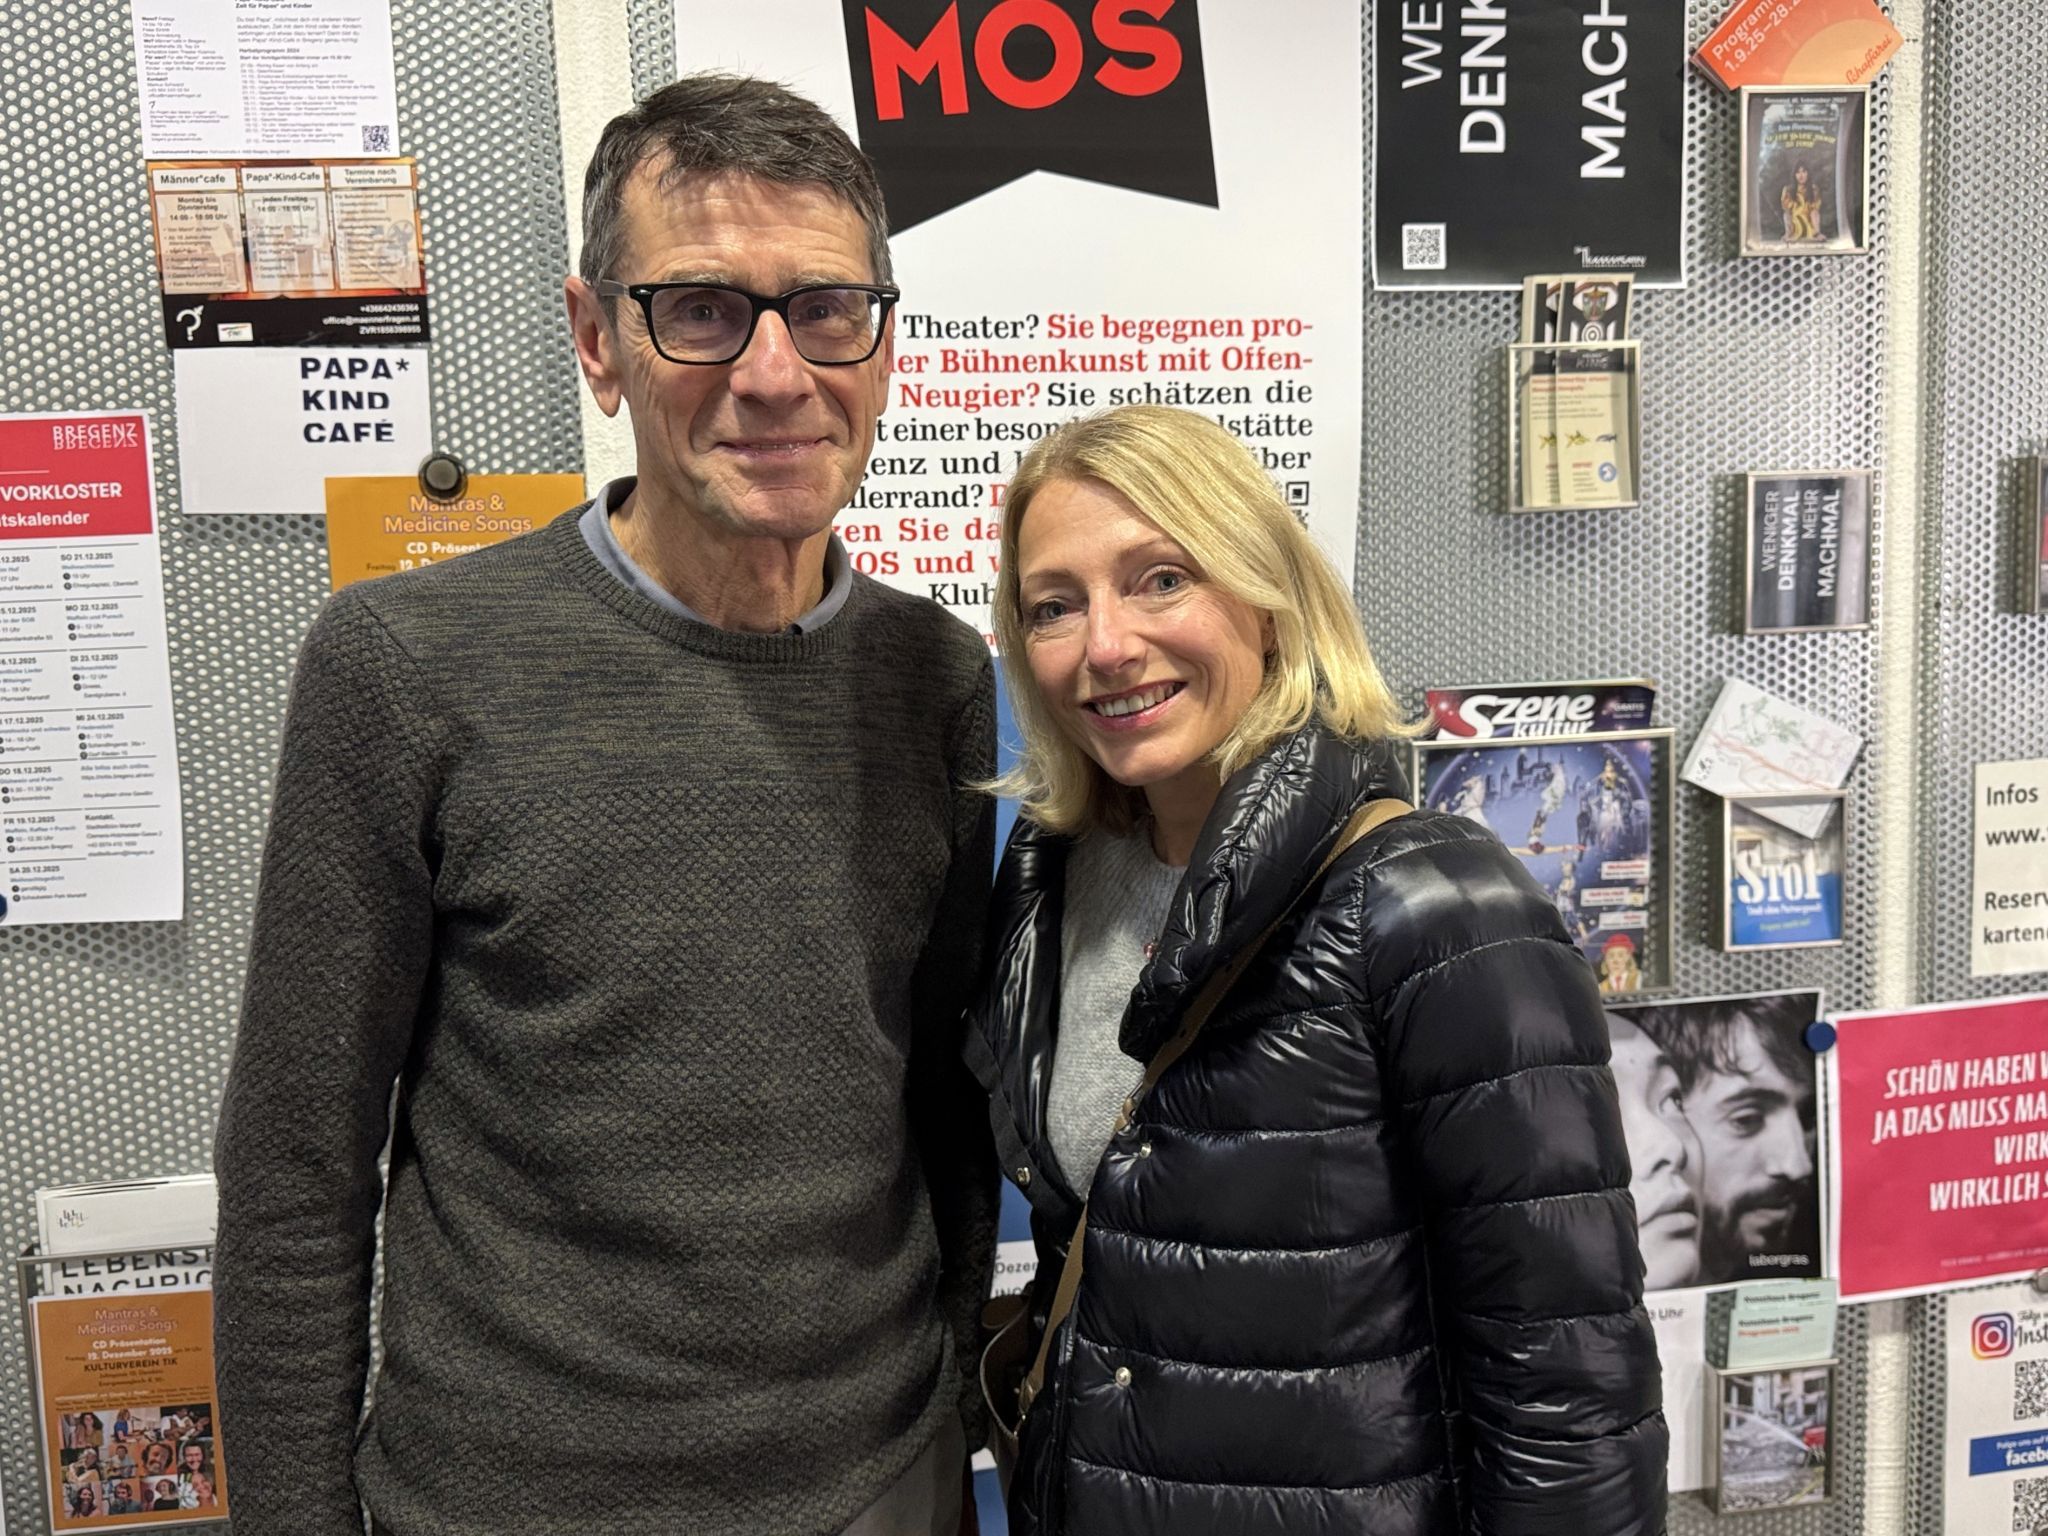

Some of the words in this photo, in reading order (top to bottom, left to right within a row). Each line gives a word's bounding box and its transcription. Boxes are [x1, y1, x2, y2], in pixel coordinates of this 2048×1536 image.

[865, 0, 1183, 121] MOS
[344, 177, 398, 185] Vereinbarung
[903, 314, 1040, 341] Theater?
[1047, 314, 1095, 340] Sie
[1101, 314, 1243, 344] begegnen
[1252, 316, 1314, 343] pro-
[891, 351, 930, 374] er
[939, 348, 1148, 375] Bühnenkunst
[1159, 347, 1212, 373] mit
[1221, 346, 1314, 371] Offen-
[302, 389, 391, 412] KIND
[899, 383, 1041, 413] Neugier?
[1047, 382, 1096, 408] Sie
[1108, 380, 1251, 407] schätzen
[1265, 379, 1313, 404] die
[53, 423, 138, 445] BREGENZ
[303, 419, 396, 444] CAFÉ
[894, 418, 970, 442] einer
[940, 450, 1002, 475] und
[0, 482, 122, 502] VORKLOSTER
[489, 494, 505, 512] &
[848, 483, 984, 509] lerrand?
[384, 516, 470, 534] Medicine
[475, 515, 533, 535] Songs
[898, 517, 950, 543] Sie
[406, 541, 428, 555] CD
[1760, 490, 1780, 573] WENIGER
[1777, 490, 1800, 591] DENKMAL
[1801, 489, 1820, 540] MEHR
[1816, 488, 1841, 598] MACHMAL
[914, 550, 975, 575] und
[1440, 693, 1596, 740] Szene
[1986, 783, 2040, 807] Infos
[1985, 826, 2048, 847] www.
[1983, 926, 2048, 945] karten
[1883, 1058, 1960, 1100] SCHÖN
[1962, 1051, 2036, 1089] HABEN
[1871, 1108, 1899, 1146] JA
[1901, 1102, 1946, 1137] DAS
[1947, 1094, 2012, 1131] MUSS
[1929, 1170, 2041, 1212] WIRKLICH
[95, 1308, 146, 1321] Mantras
[77, 1321, 136, 1336] Medicine
[139, 1318, 178, 1333] Songs
[92, 1340, 108, 1351] CD
[109, 1337, 167, 1349] Präsentation
[83, 1358, 160, 1373] KULTURVEREIN
[162, 1357, 178, 1367] TIK
